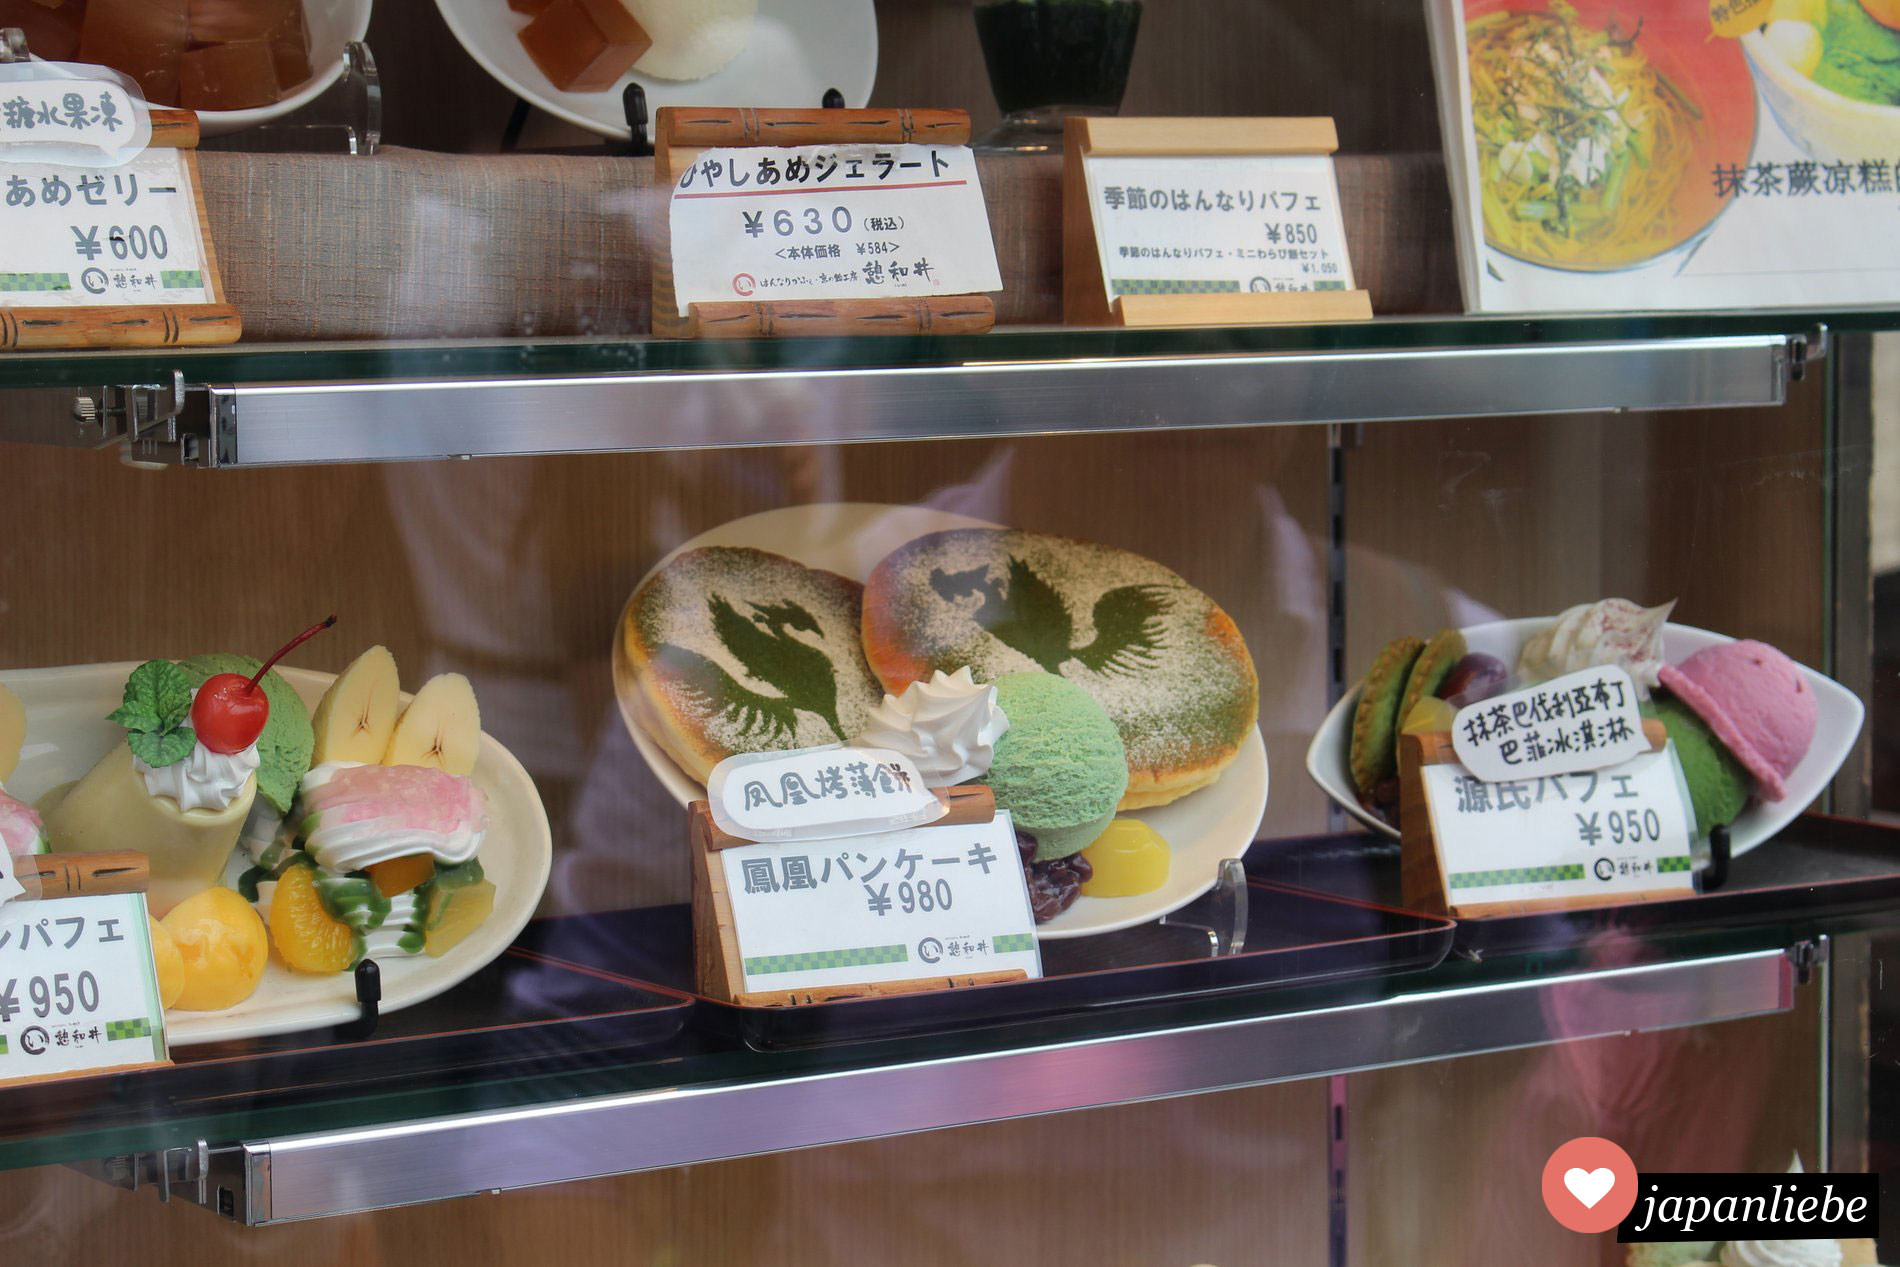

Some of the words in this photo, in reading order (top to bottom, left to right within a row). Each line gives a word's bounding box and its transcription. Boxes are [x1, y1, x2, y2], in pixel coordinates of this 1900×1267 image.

[6, 174, 176, 207] あめゼリー
[1711, 159, 1900, 198] 抹茶蕨凉糕
[1104, 186, 1321, 212] 季節のはんなりパフェ
[742, 206, 852, 238] ¥630
[1265, 222, 1318, 245] ¥850
[70, 224, 168, 261] ¥600
[1575, 808, 1660, 846] ¥950
[740, 842, 998, 895] 鳳凰パンケーキ
[863, 878, 953, 917] ¥980
